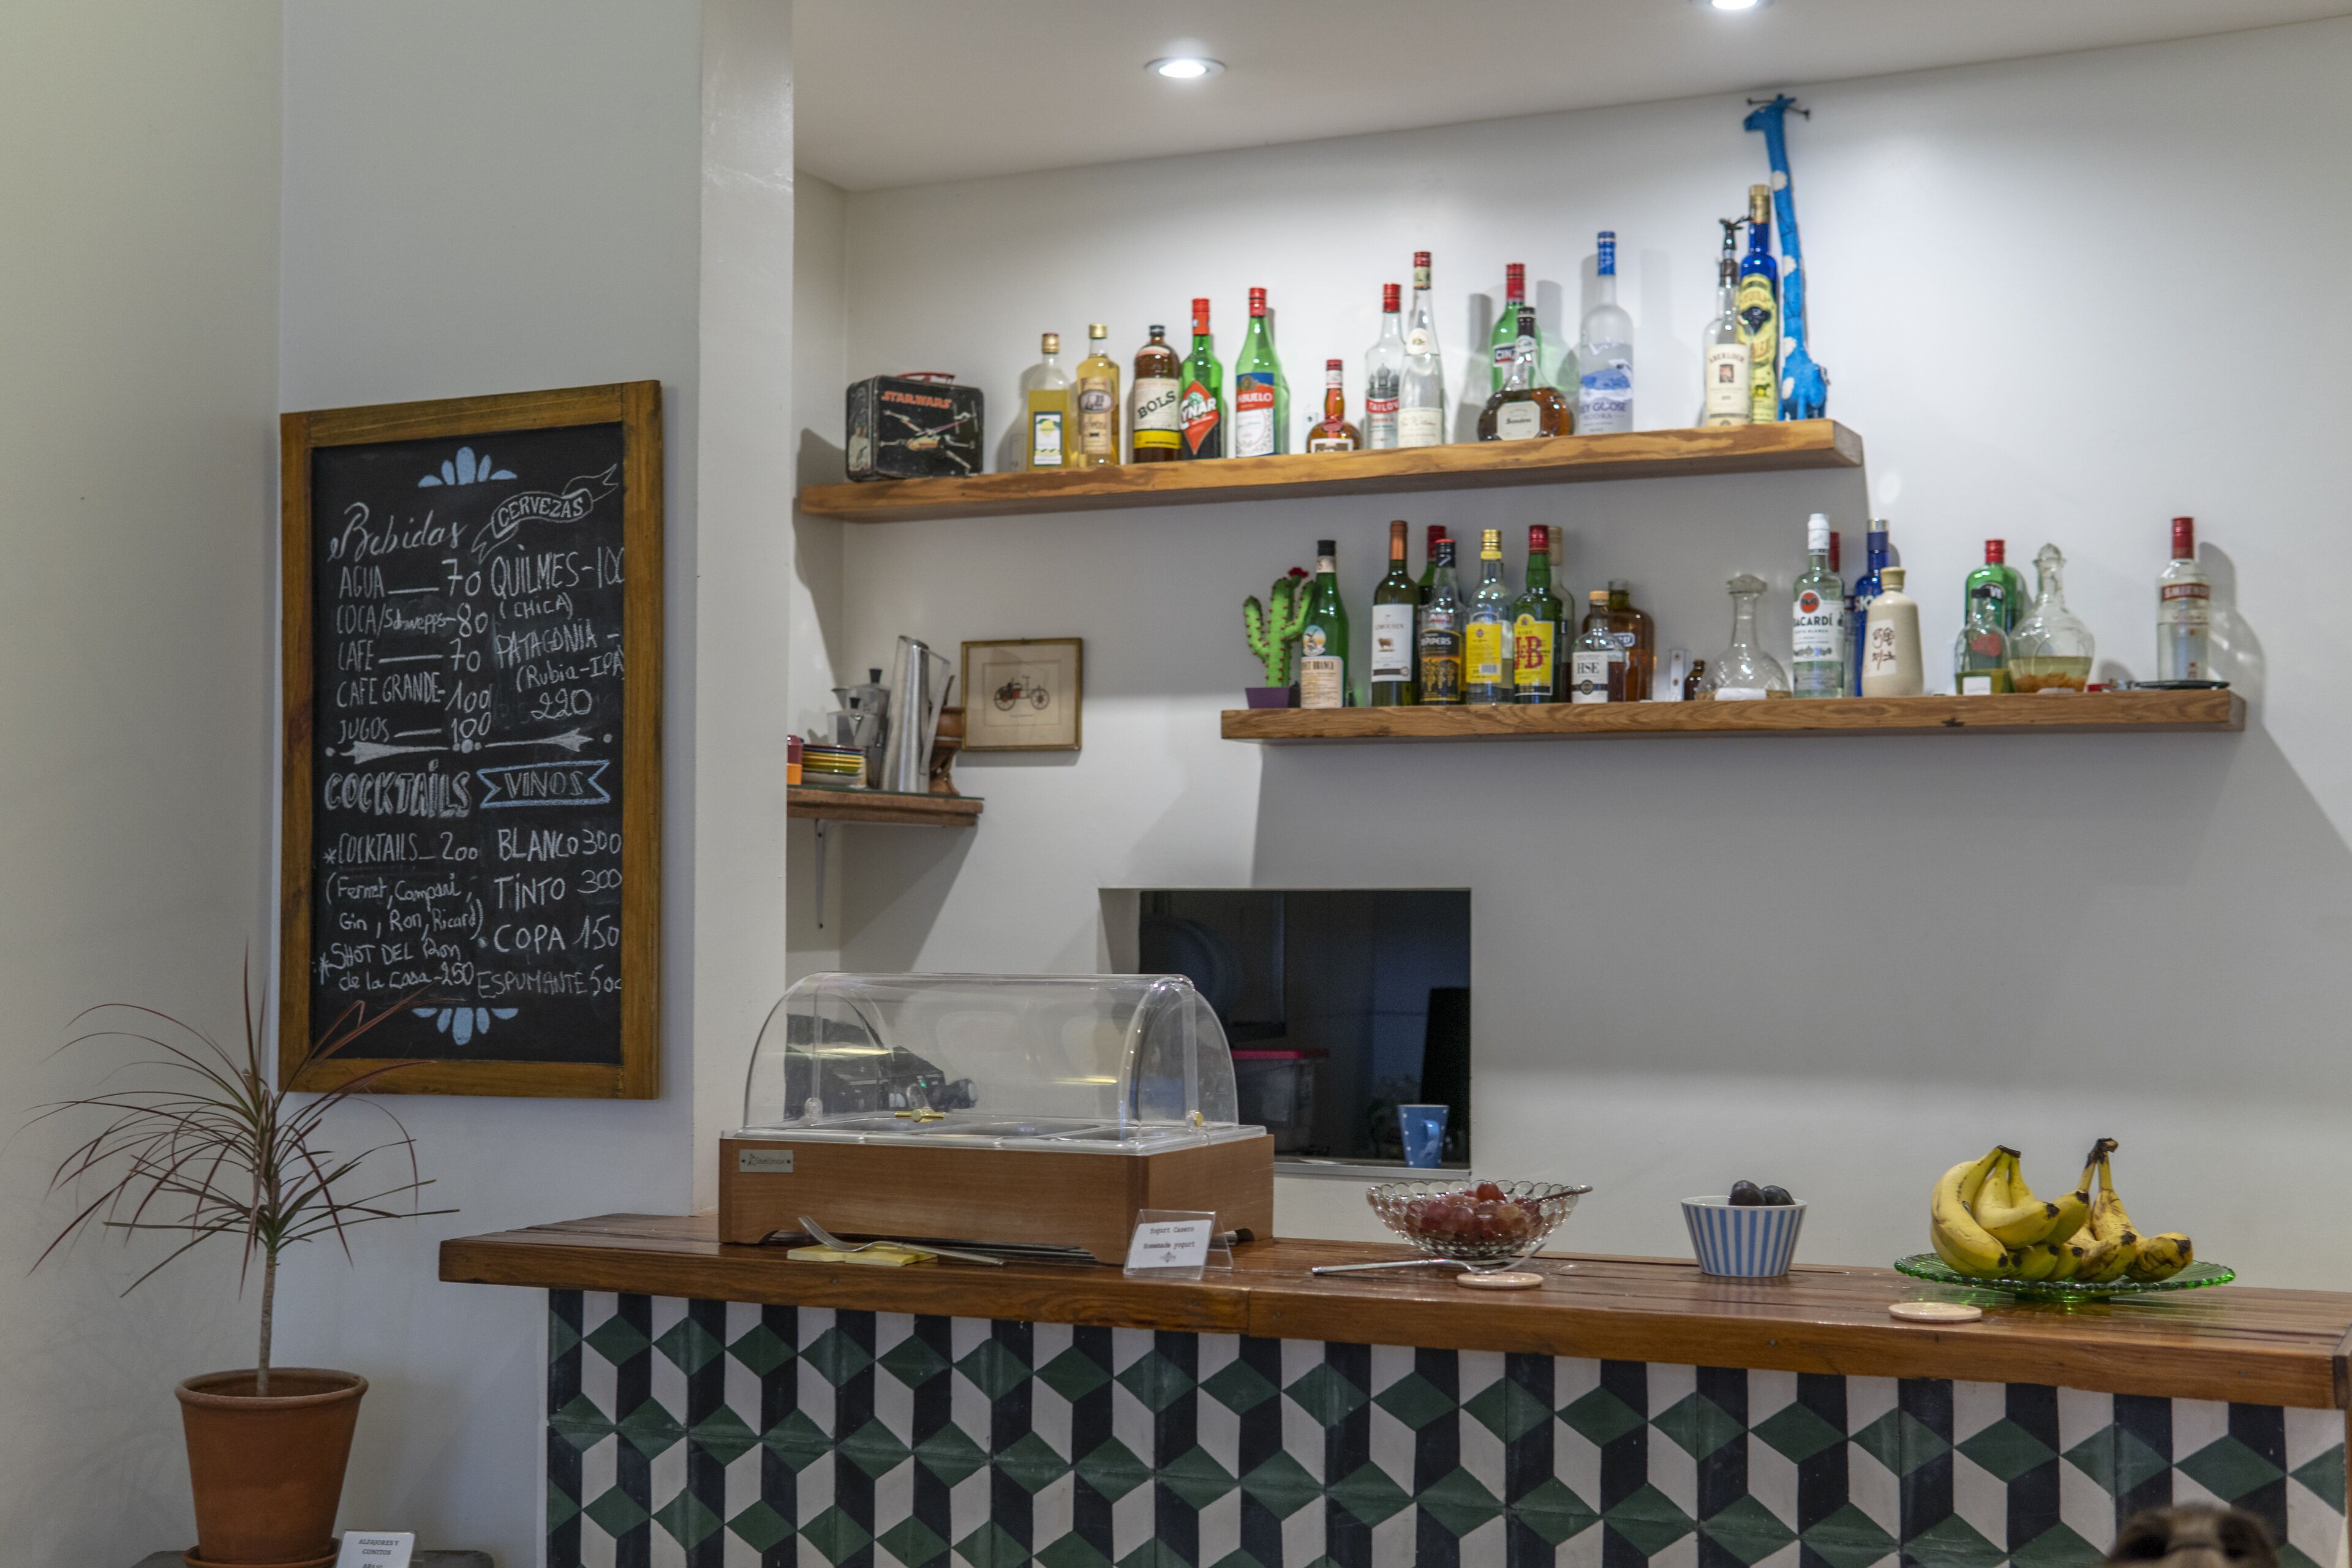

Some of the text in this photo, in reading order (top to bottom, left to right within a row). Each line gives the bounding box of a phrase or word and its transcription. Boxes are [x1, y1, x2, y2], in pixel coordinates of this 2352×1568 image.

[881, 390, 952, 409] STAR WARS
[1137, 390, 1176, 420] BOLS
[1180, 397, 1216, 431] CYNAR
[1593, 401, 1627, 412] GOOSE
[498, 495, 584, 529] CERVEZAS
[339, 558, 481, 599] AGUA 70
[338, 638, 481, 672] CAFE 70
[1577, 662, 1599, 674] HSE
[336, 677, 378, 707] CAFE
[445, 679, 492, 713] 100
[337, 712, 491, 744] JUGOS 100
[504, 770, 585, 799] VINOS
[440, 831, 479, 861] 200
[497, 827, 622, 861] BLANCO 300
[577, 868, 623, 894] 300
[494, 914, 620, 954] COPA 150
[381, 943, 415, 965] DEL
[423, 937, 461, 962] Ron
[339, 970, 360, 991] de
[366, 971, 385, 991] la
[477, 970, 588, 999] ESPUMANTE
